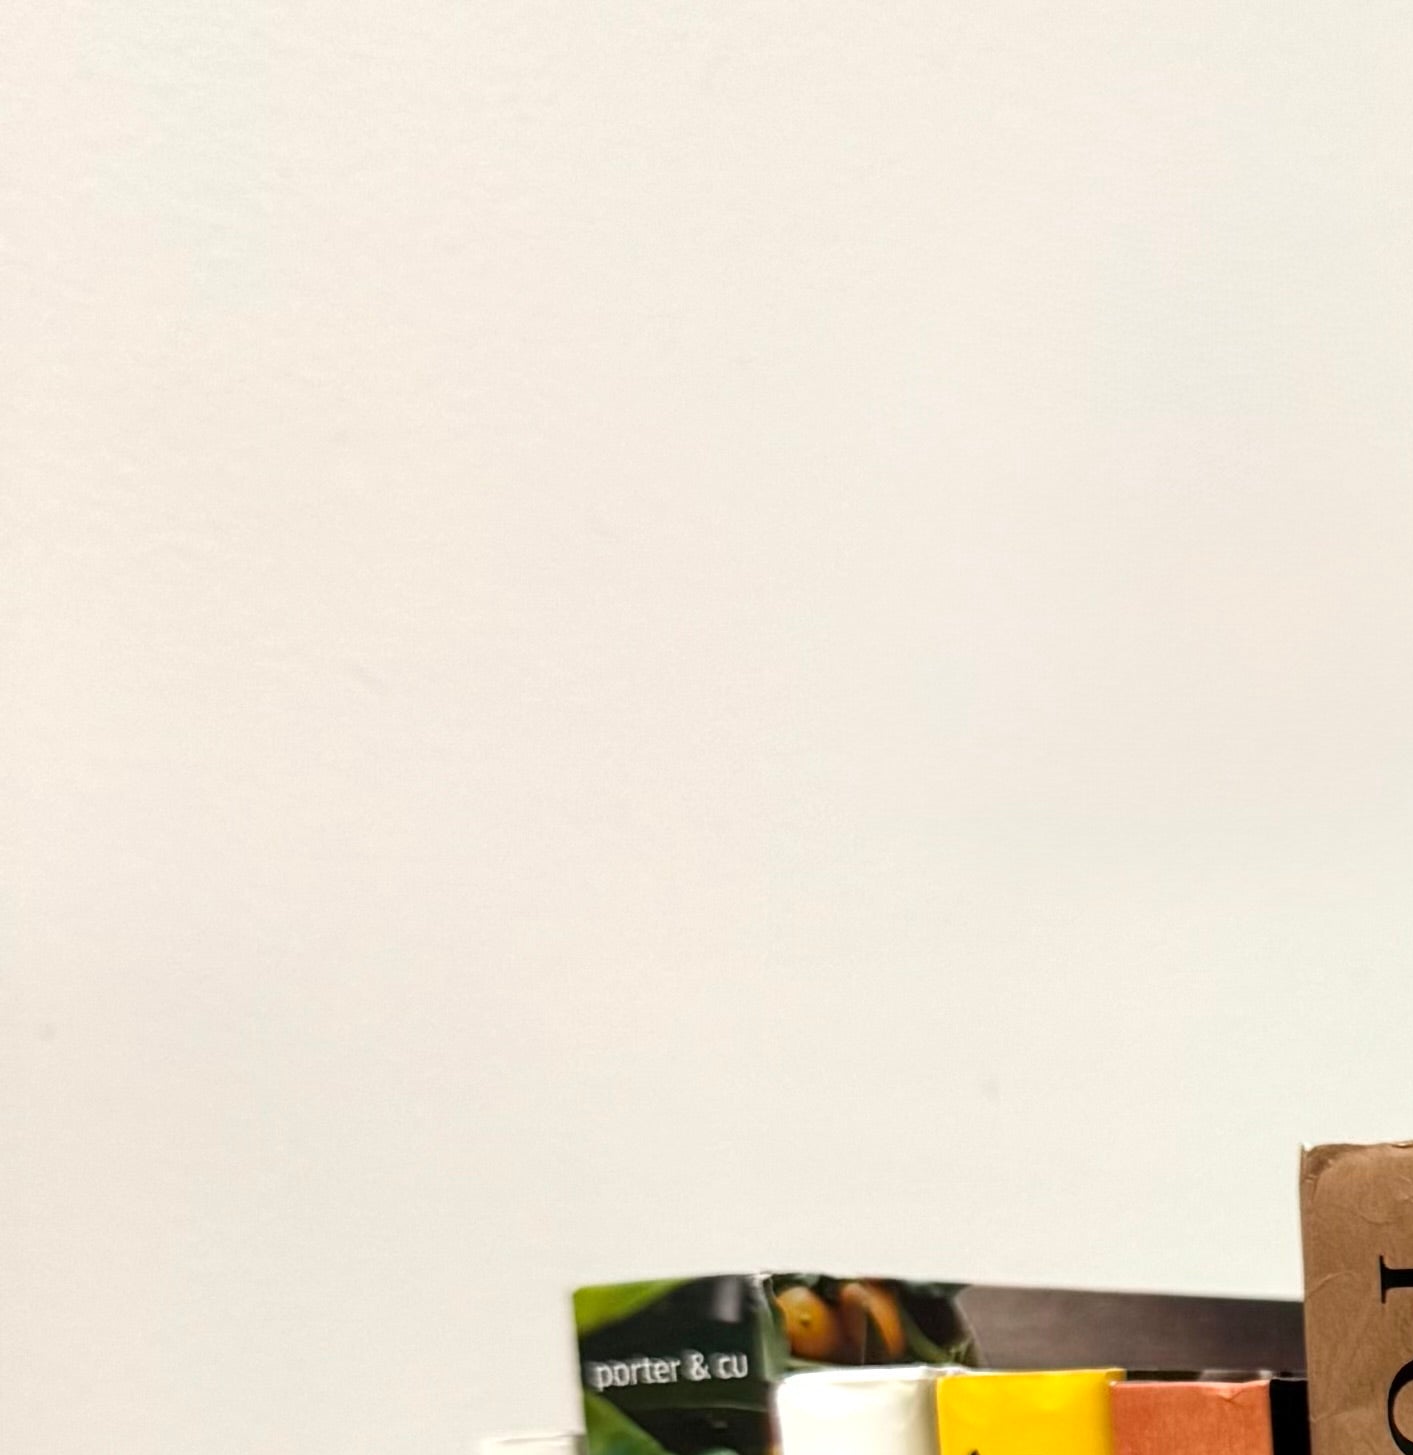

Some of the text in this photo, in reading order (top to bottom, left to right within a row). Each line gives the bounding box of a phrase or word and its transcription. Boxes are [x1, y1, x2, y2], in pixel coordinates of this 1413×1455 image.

[590, 1350, 749, 1393] porter & cu
